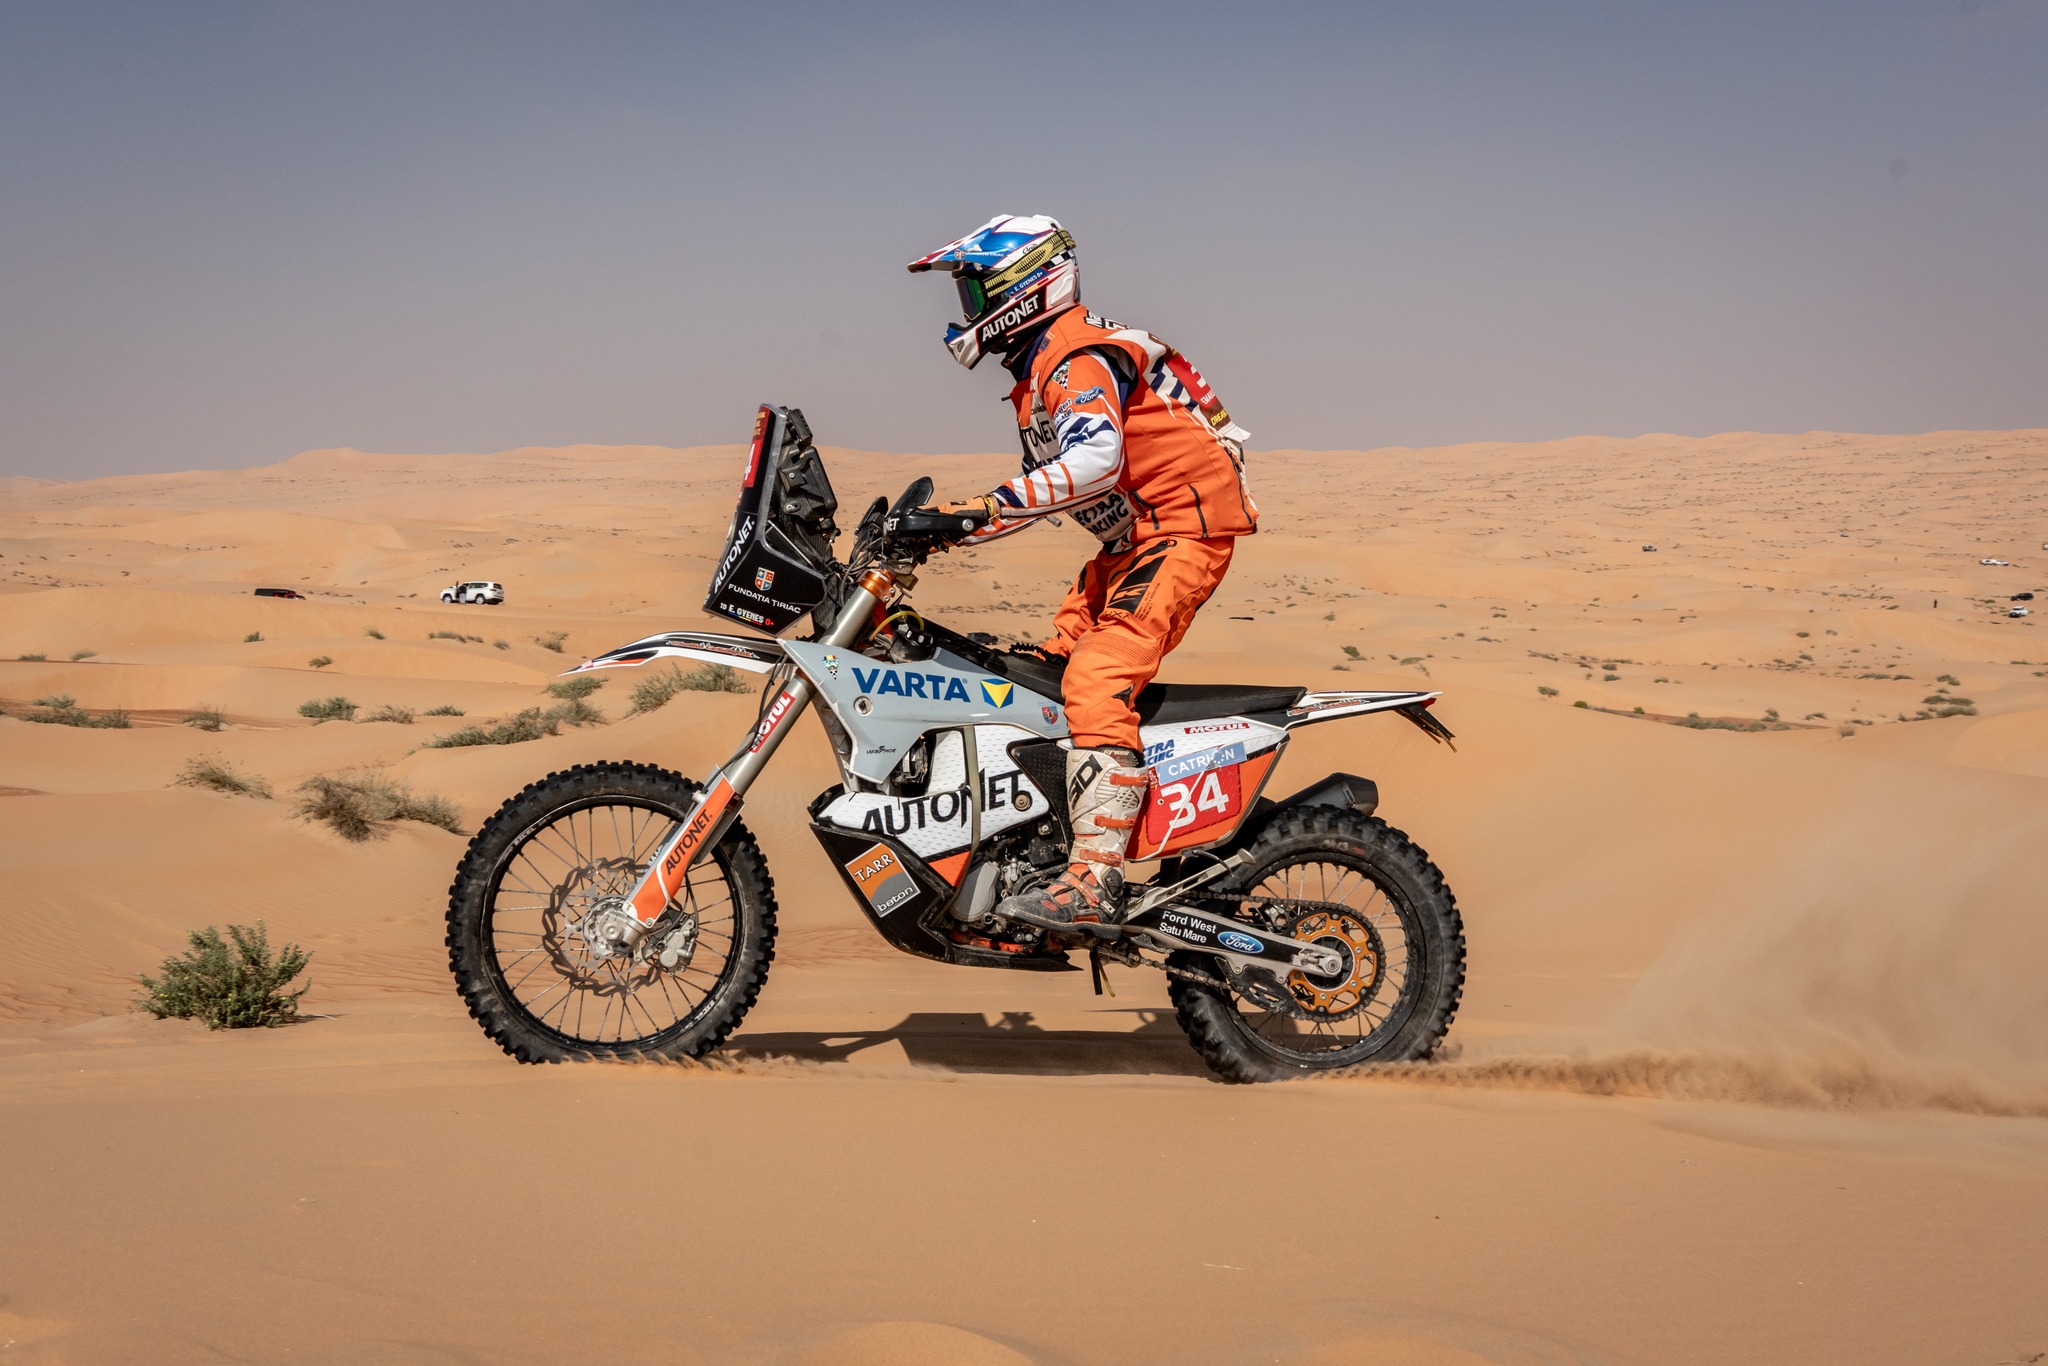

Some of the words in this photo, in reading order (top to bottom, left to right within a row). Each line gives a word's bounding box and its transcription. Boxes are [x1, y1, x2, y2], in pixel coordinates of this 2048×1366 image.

[982, 295, 1039, 342] AUTONET
[715, 515, 753, 594] AUTONET
[736, 607, 765, 624] GYENES
[771, 598, 801, 614] TIRIAC
[851, 667, 971, 702] VARTA
[752, 696, 791, 751] MOTUL
[1189, 722, 1247, 734] MOTUL
[861, 767, 1024, 836] AUTONET
[1160, 772, 1230, 829] 34
[665, 809, 710, 876] AUTONET
[854, 853, 894, 882] TARR
[877, 886, 914, 912] beton
[1159, 922, 1182, 936] Satu
[1182, 928, 1207, 943] Mare
[1162, 910, 1188, 926] Ford
[1190, 917, 1217, 934] West
[1225, 933, 1256, 952] Ford
